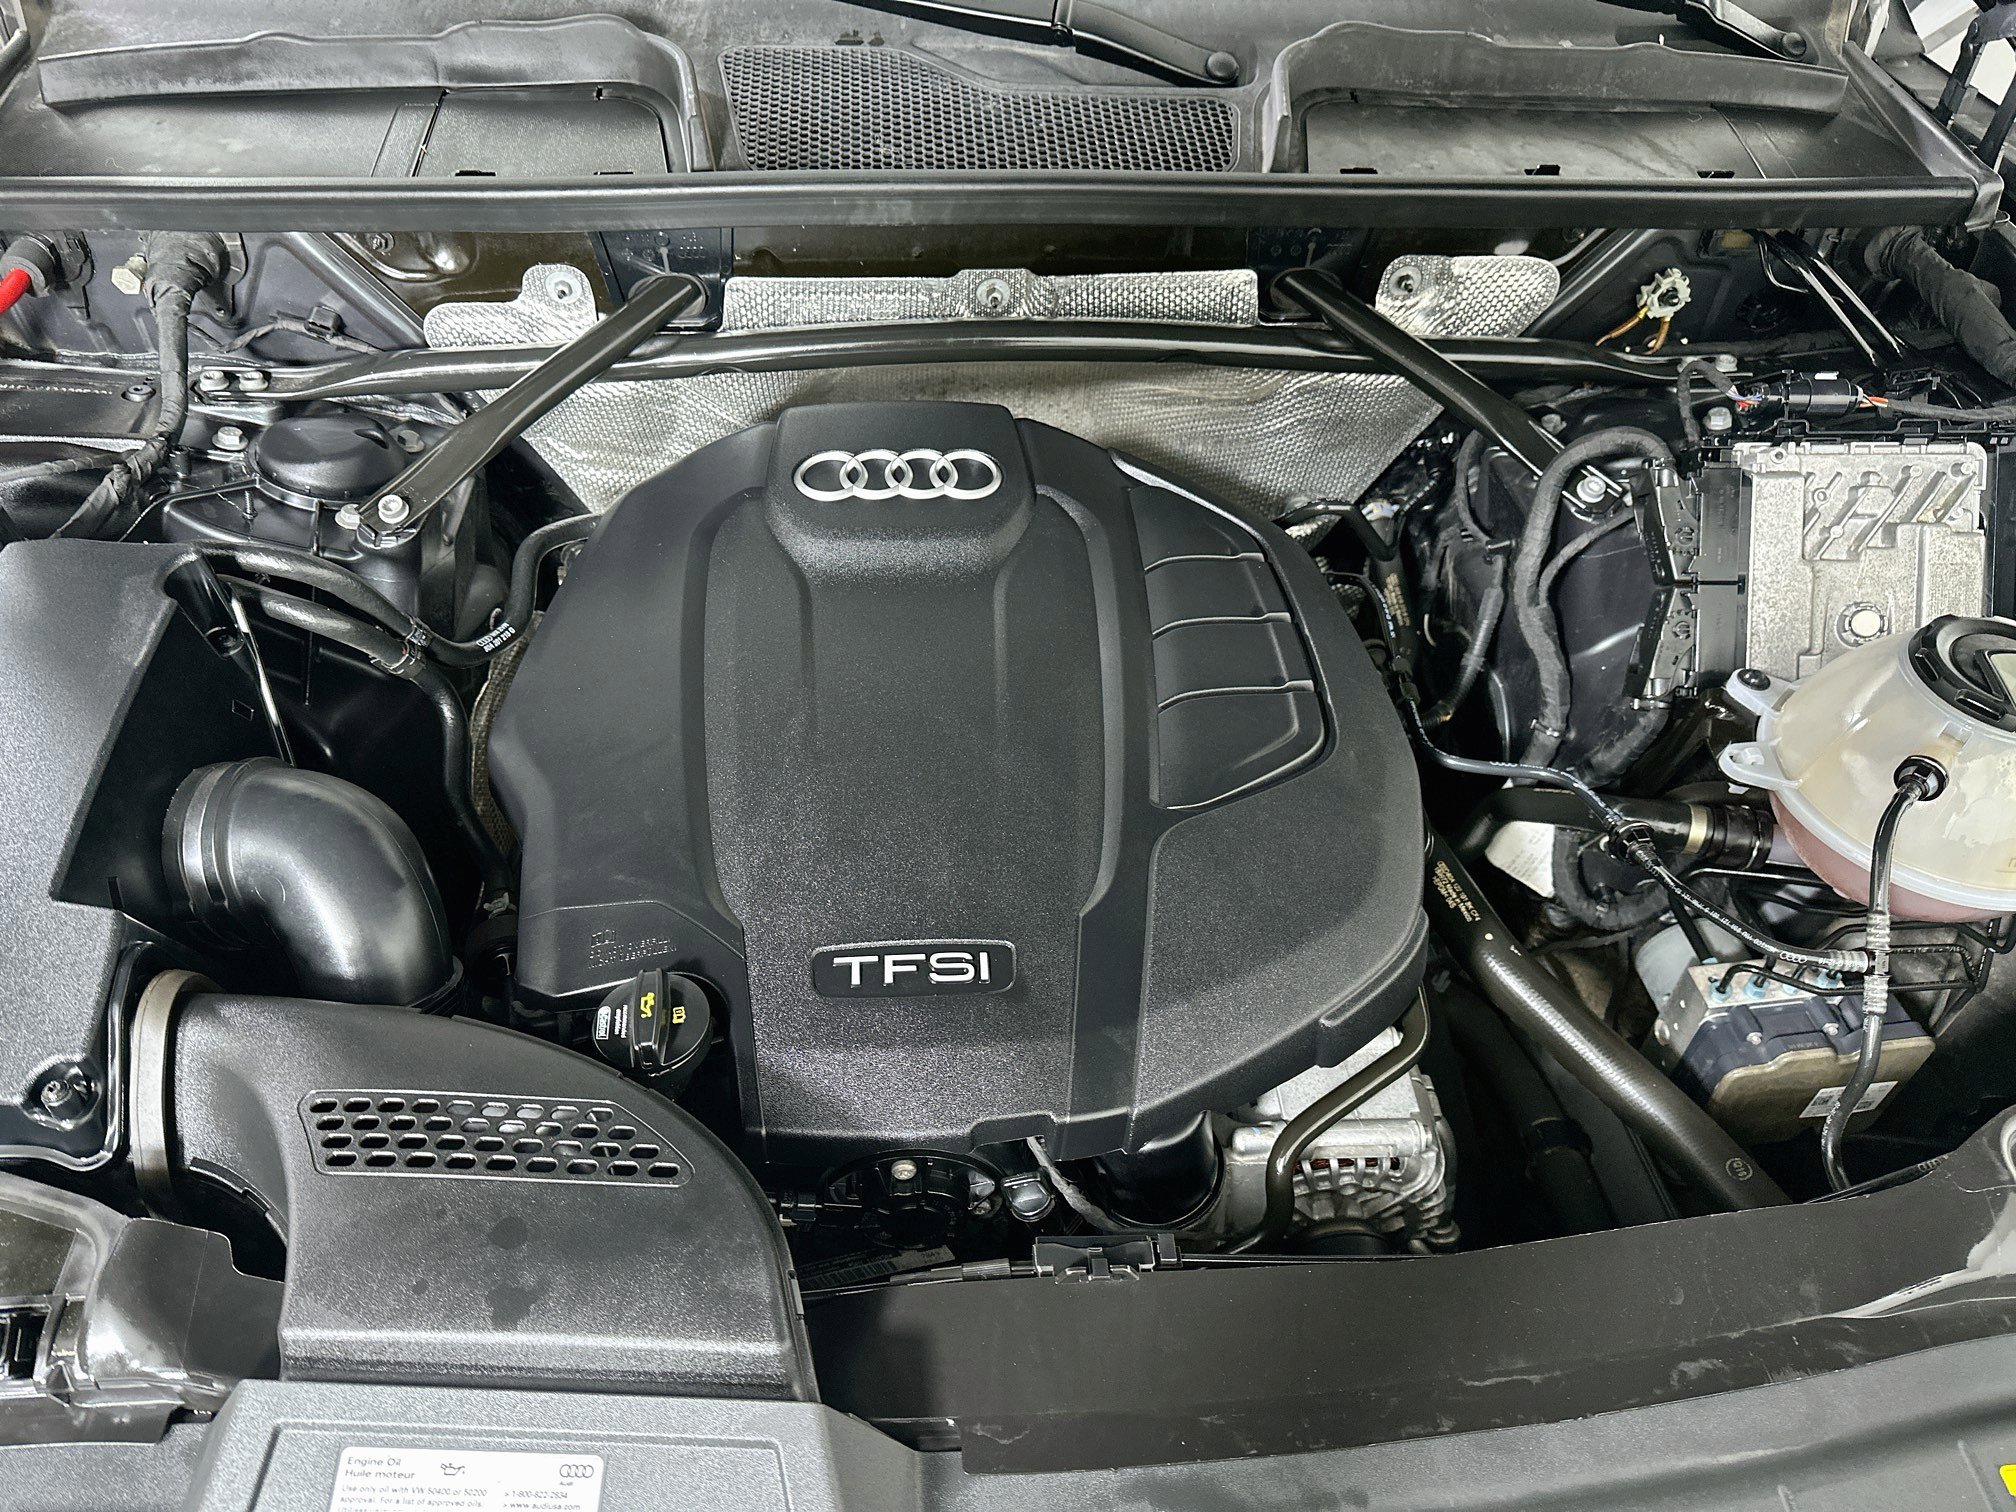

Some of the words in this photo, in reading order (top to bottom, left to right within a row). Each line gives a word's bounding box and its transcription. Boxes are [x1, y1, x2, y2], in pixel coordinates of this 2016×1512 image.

[833, 952, 990, 986] TFSI
[598, 1014, 607, 1037] Castrol
[347, 1457, 383, 1467] Engine
[387, 1457, 401, 1466] Oil
[345, 1469, 371, 1478] Huile
[375, 1471, 415, 1479] moteur
[359, 1486, 376, 1494] only
[402, 1497, 414, 1505] list
[427, 1498, 465, 1507] approved
